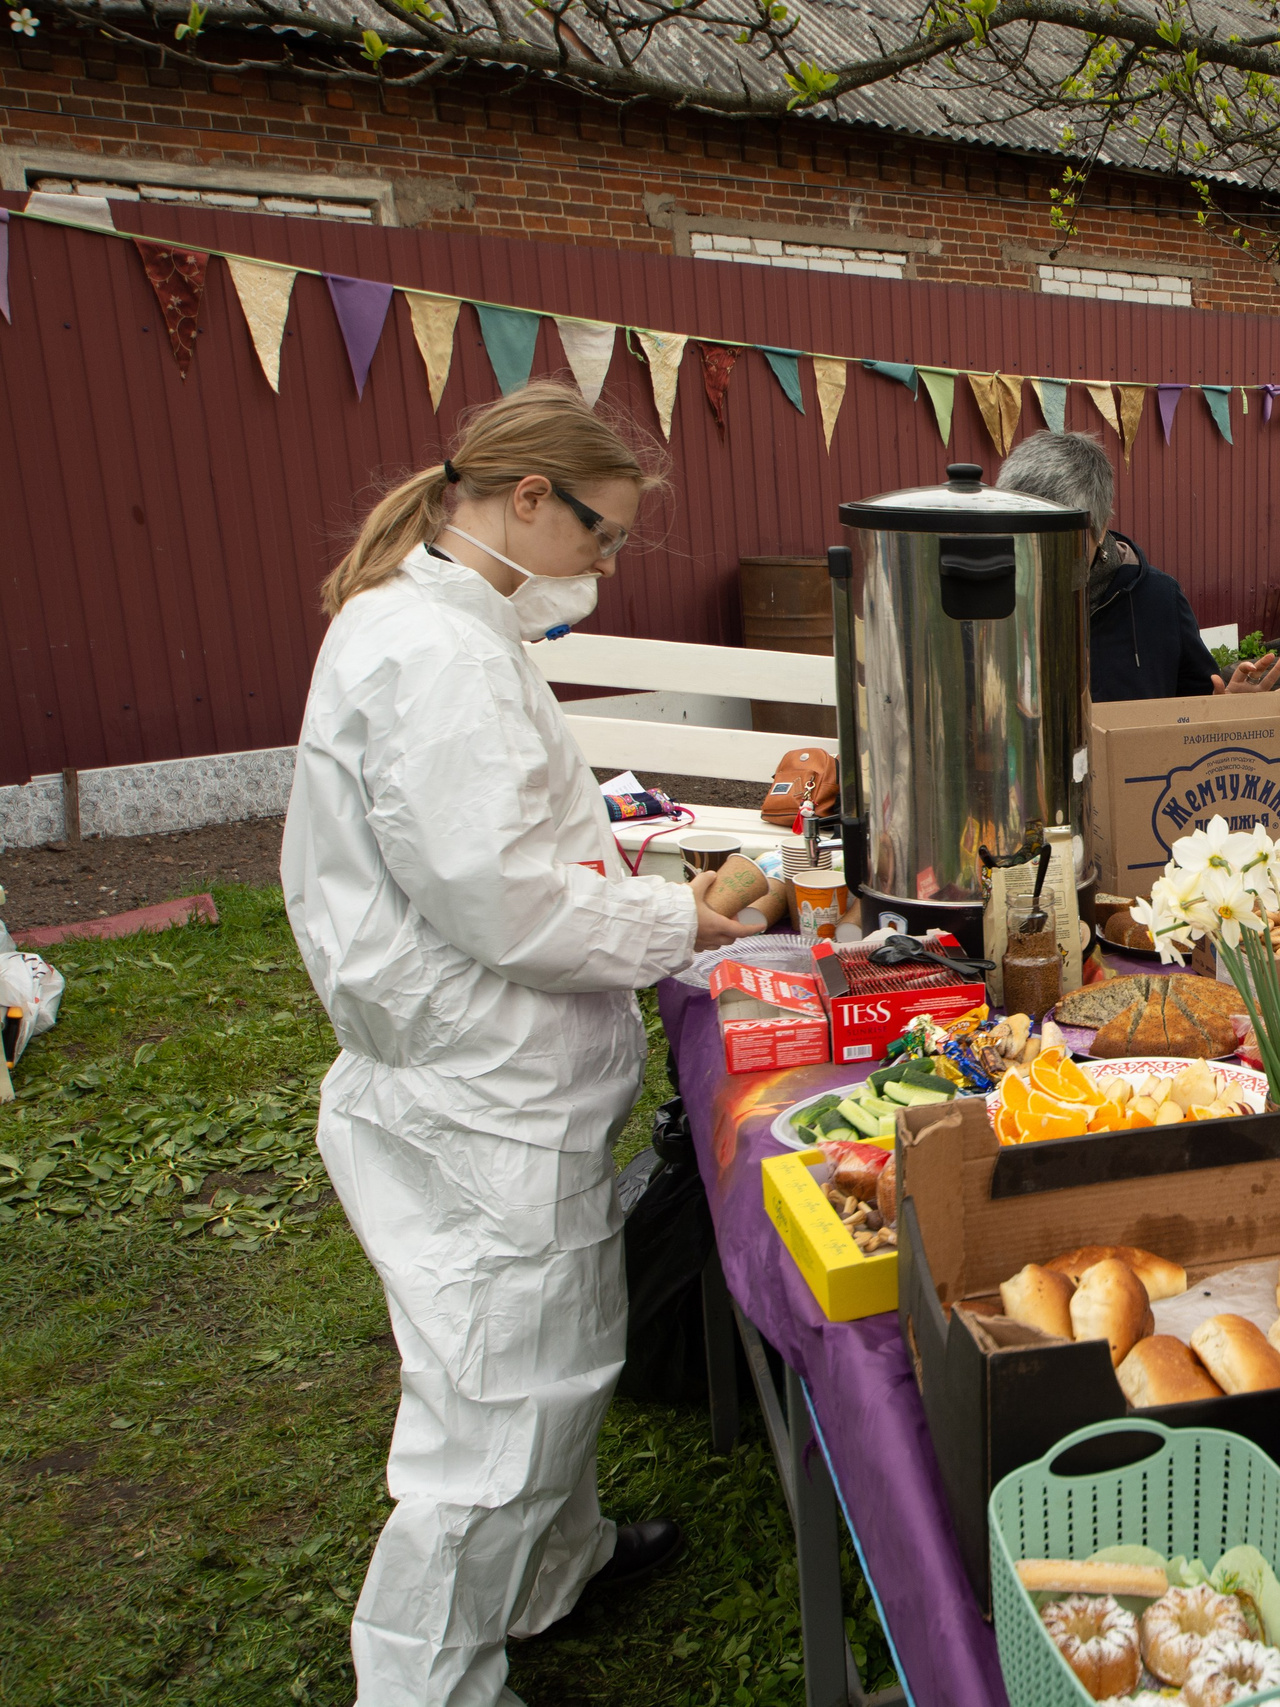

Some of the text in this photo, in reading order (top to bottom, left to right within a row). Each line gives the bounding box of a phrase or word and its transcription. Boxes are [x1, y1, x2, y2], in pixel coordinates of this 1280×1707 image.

[1183, 729, 1275, 745] РАФИНИРОВАННОЕ
[1230, 756, 1256, 764] ПРОДУКТ
[837, 999, 892, 1027] TESS
[846, 1025, 888, 1037] SUNRISE
